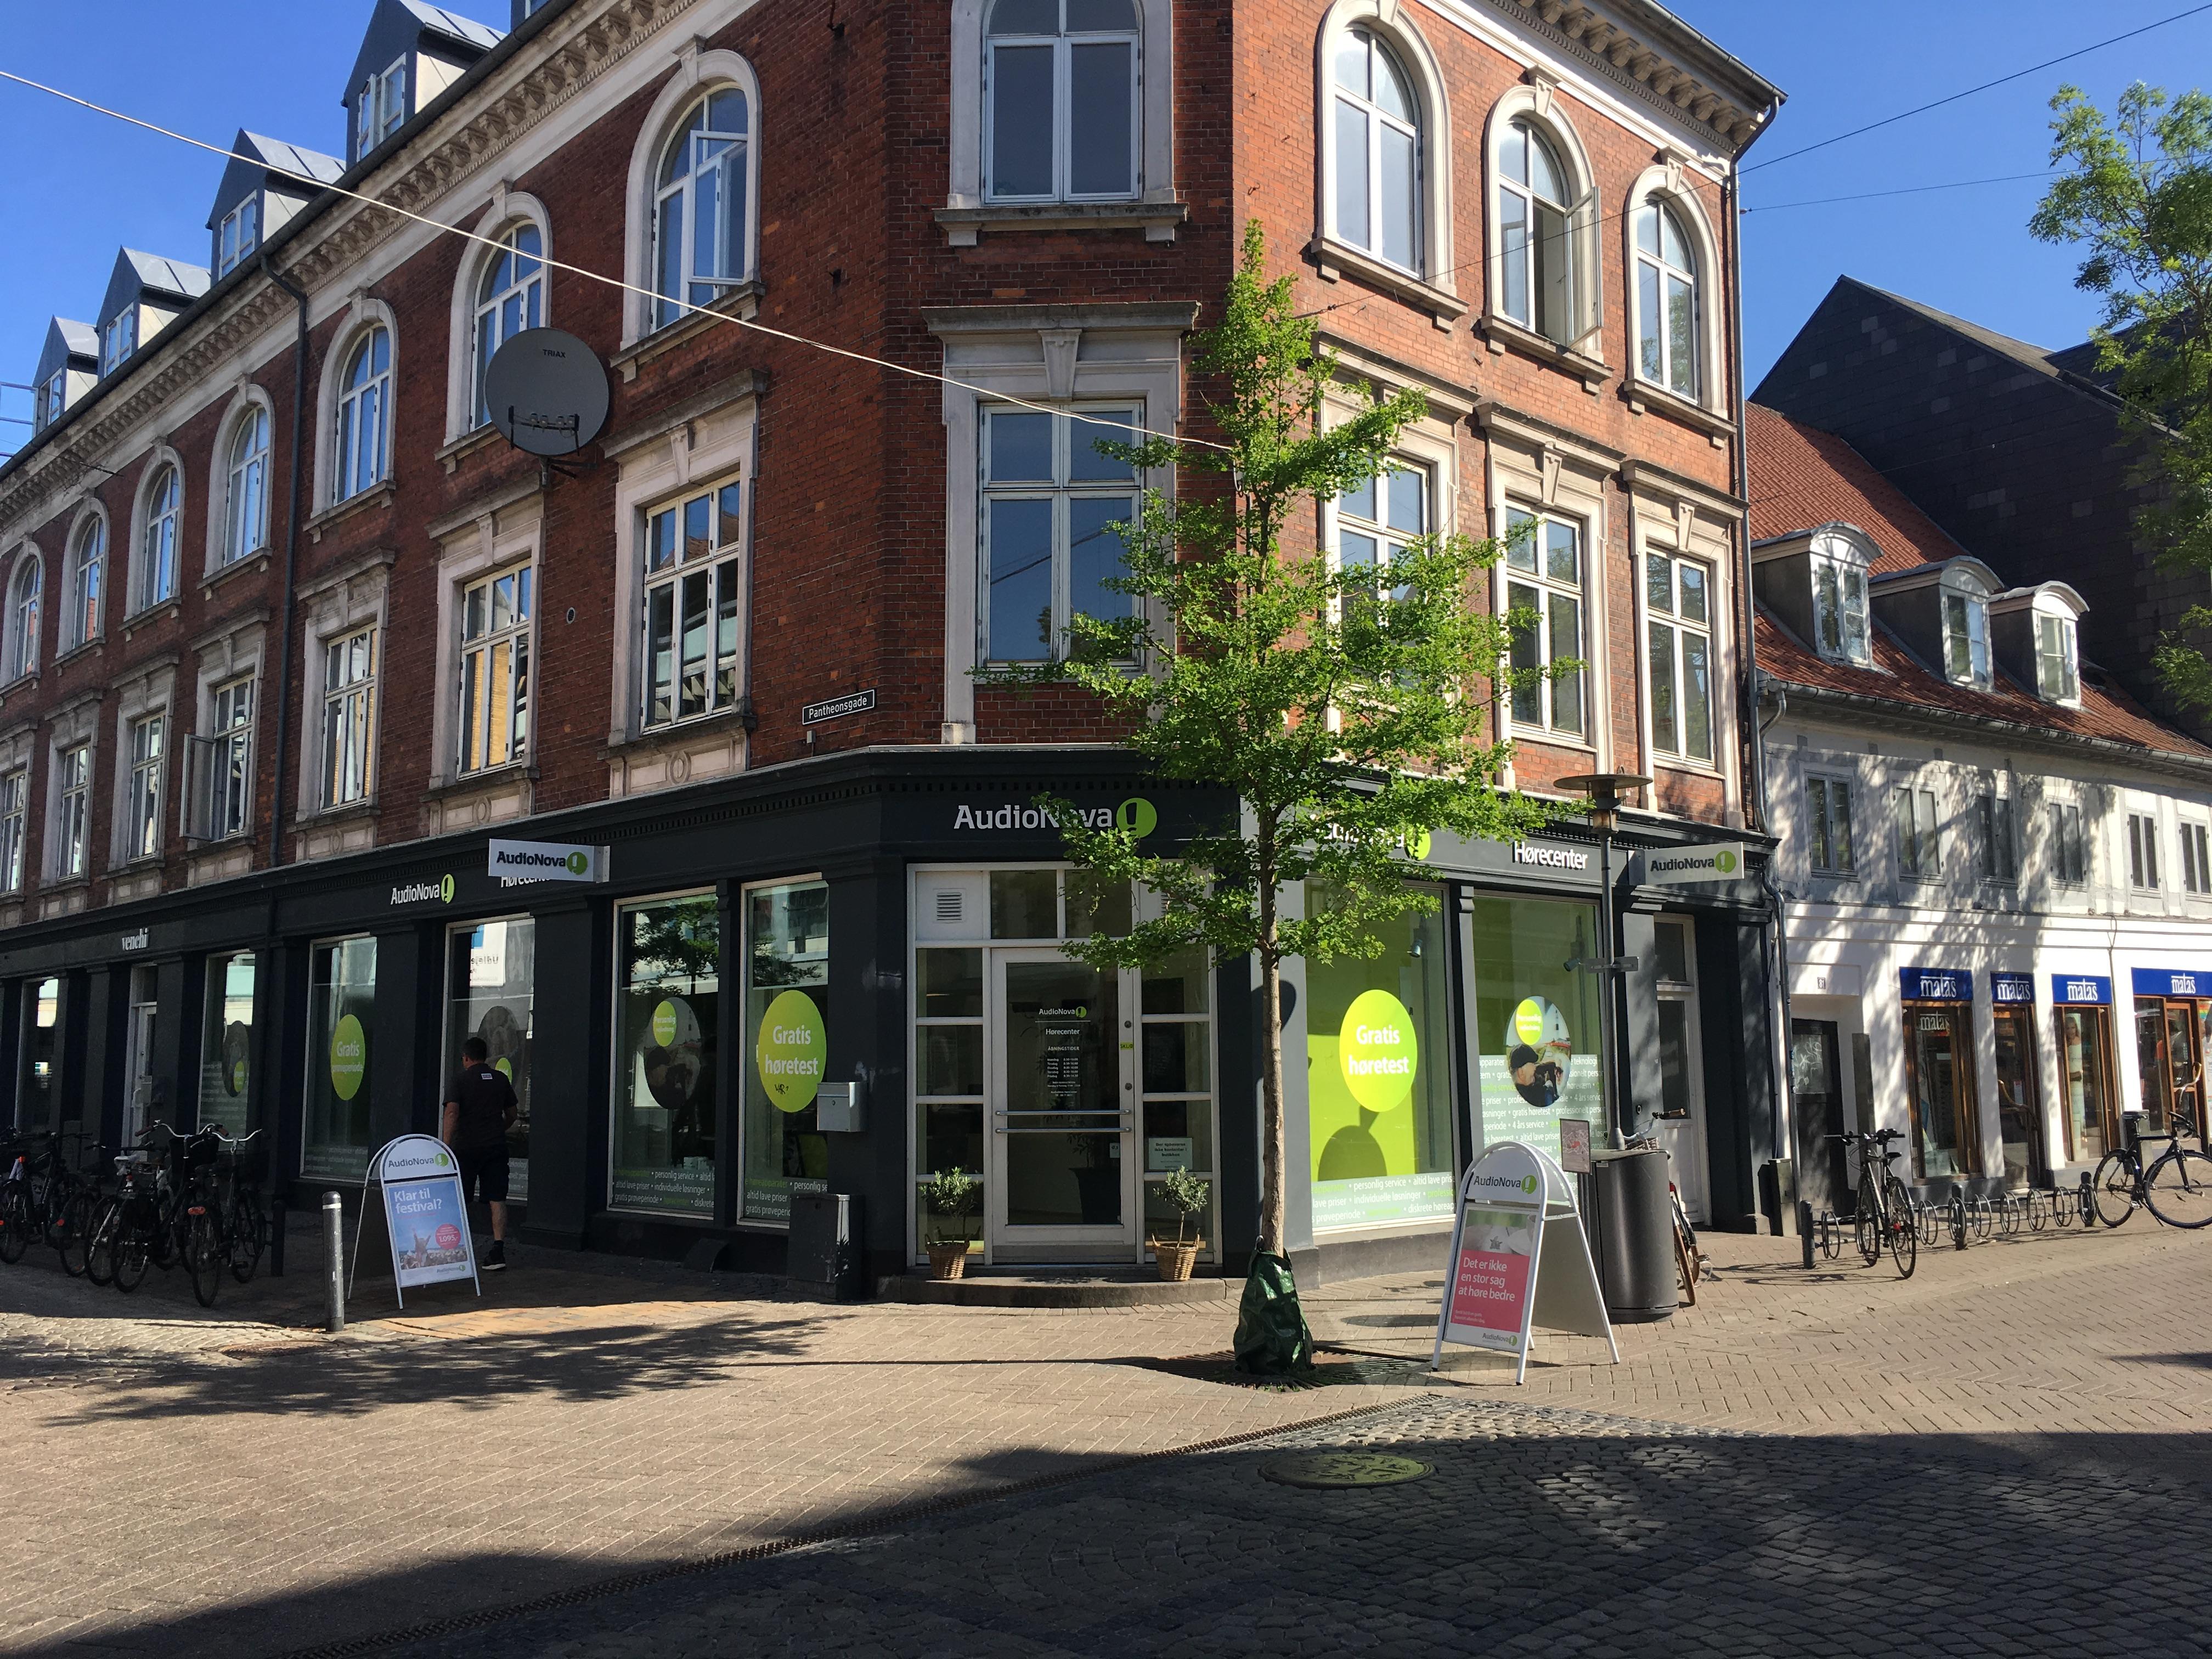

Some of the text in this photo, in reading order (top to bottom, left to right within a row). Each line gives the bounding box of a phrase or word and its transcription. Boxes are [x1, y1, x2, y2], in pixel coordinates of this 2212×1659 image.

[543, 349, 566, 358] TRIAX
[809, 696, 867, 719] Pantheonsgade
[496, 851, 566, 867] AudioNova
[1515, 841, 1588, 869] Hørecenter
[1650, 858, 1715, 872] AudioNova
[390, 883, 439, 905] AudioNova
[1819, 979, 1825, 988] 81
[1920, 972, 1957, 997] matas
[1997, 977, 2030, 1000] matas
[2067, 978, 2098, 1001] matas
[2171, 973, 2196, 994] matas
[1920, 1011, 1950, 1031] matas
[773, 1024, 811, 1045] Gratis
[1356, 1024, 1400, 1045] Gratis
[337, 1041, 360, 1057] Gratis
[765, 1054, 819, 1075] høretest
[1348, 1054, 1409, 1075] høretest
[1513, 1108, 1528, 1119] gratis
[1528, 1108, 1550, 1116] høretest
[1520, 1132, 1532, 1141] altid
[1533, 1132, 1544, 1140] lave
[388, 1156, 435, 1168] AudioNova
[654, 1171, 677, 1181] personlig
[1353, 1178, 1384, 1192] personlig
[1385, 1178, 1406, 1188] service
[1413, 1175, 1426, 1185] altid
[1427, 1175, 1440, 1184] lave
[1474, 1176, 1521, 1188] AudioNova
[394, 1188, 430, 1202] Klar til
[794, 1181, 821, 1193] personlig
[747, 1190, 788, 1203] altid lave priser
[1312, 1198, 1327, 1208] lave
[1328, 1197, 1346, 1207] priser
[1354, 1193, 1391, 1204] individuelle
[1392, 1191, 1421, 1203] løsninger
[395, 1199, 443, 1214] festival?
[746, 1204, 761, 1215] gratis
[1316, 1210, 1361, 1224] prøveperiode
[1408, 1202, 1432, 1214] diskrete
[1463, 1257, 1507, 1272] Det er ikke
[1461, 1274, 1505, 1289] en stor sag
[1458, 1286, 1515, 1302] at høre bedre
[1482, 1333, 1509, 1342] AudioNova
